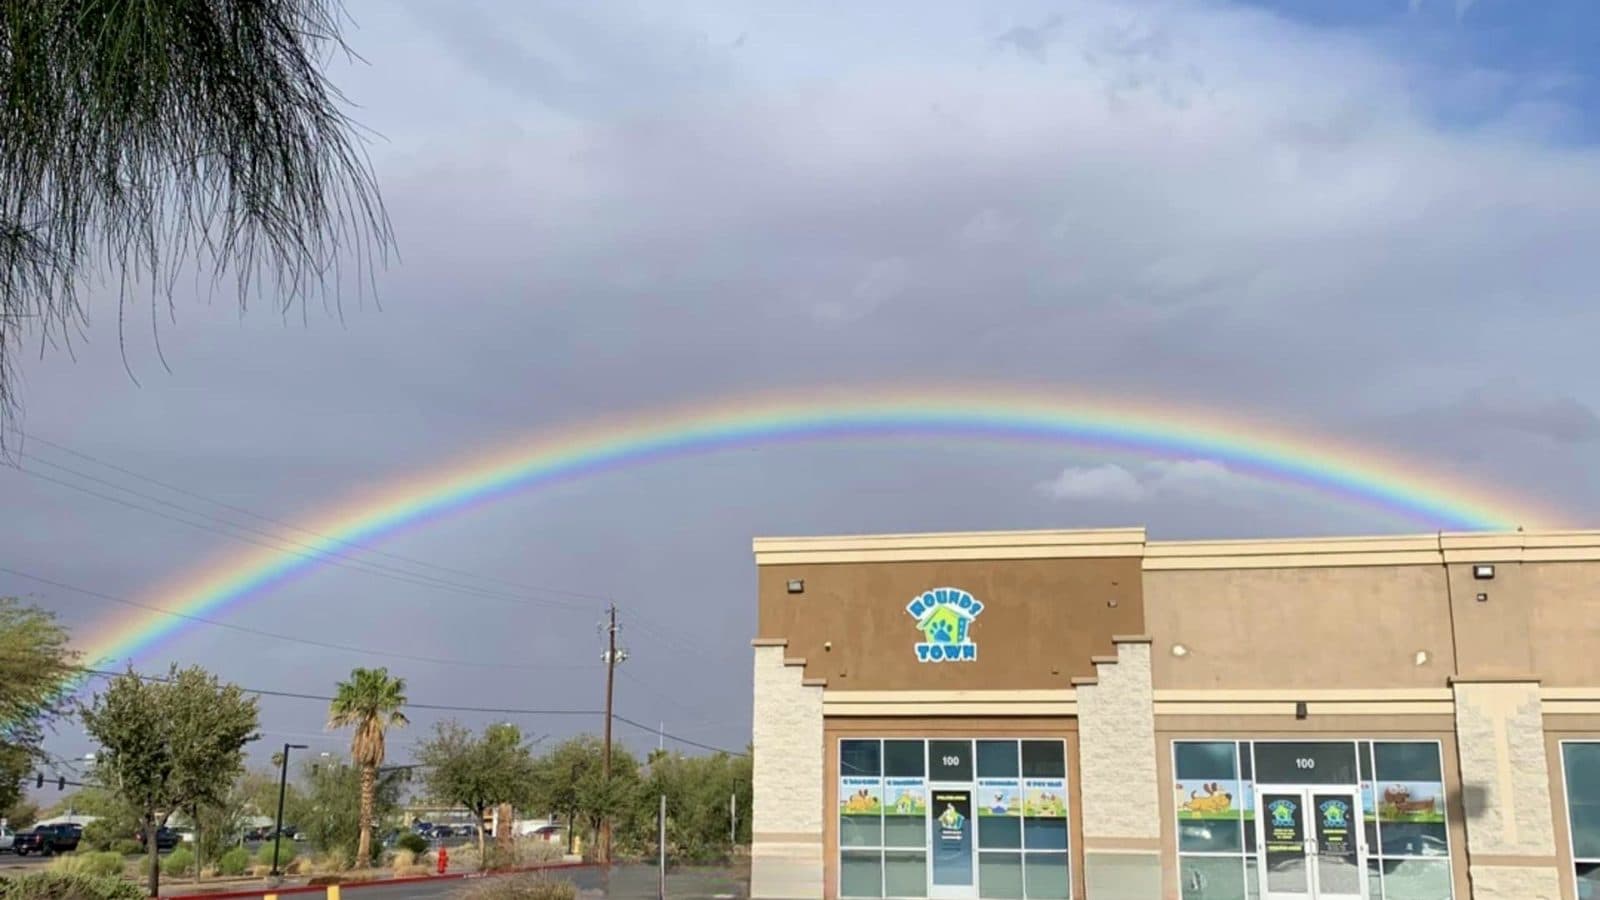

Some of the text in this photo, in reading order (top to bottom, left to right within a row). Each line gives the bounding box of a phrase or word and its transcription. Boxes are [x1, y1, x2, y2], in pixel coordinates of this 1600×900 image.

[907, 588, 983, 618] HOUNDS
[916, 644, 976, 661] TOWN
[943, 756, 960, 766] 100
[1296, 758, 1314, 769] 100
